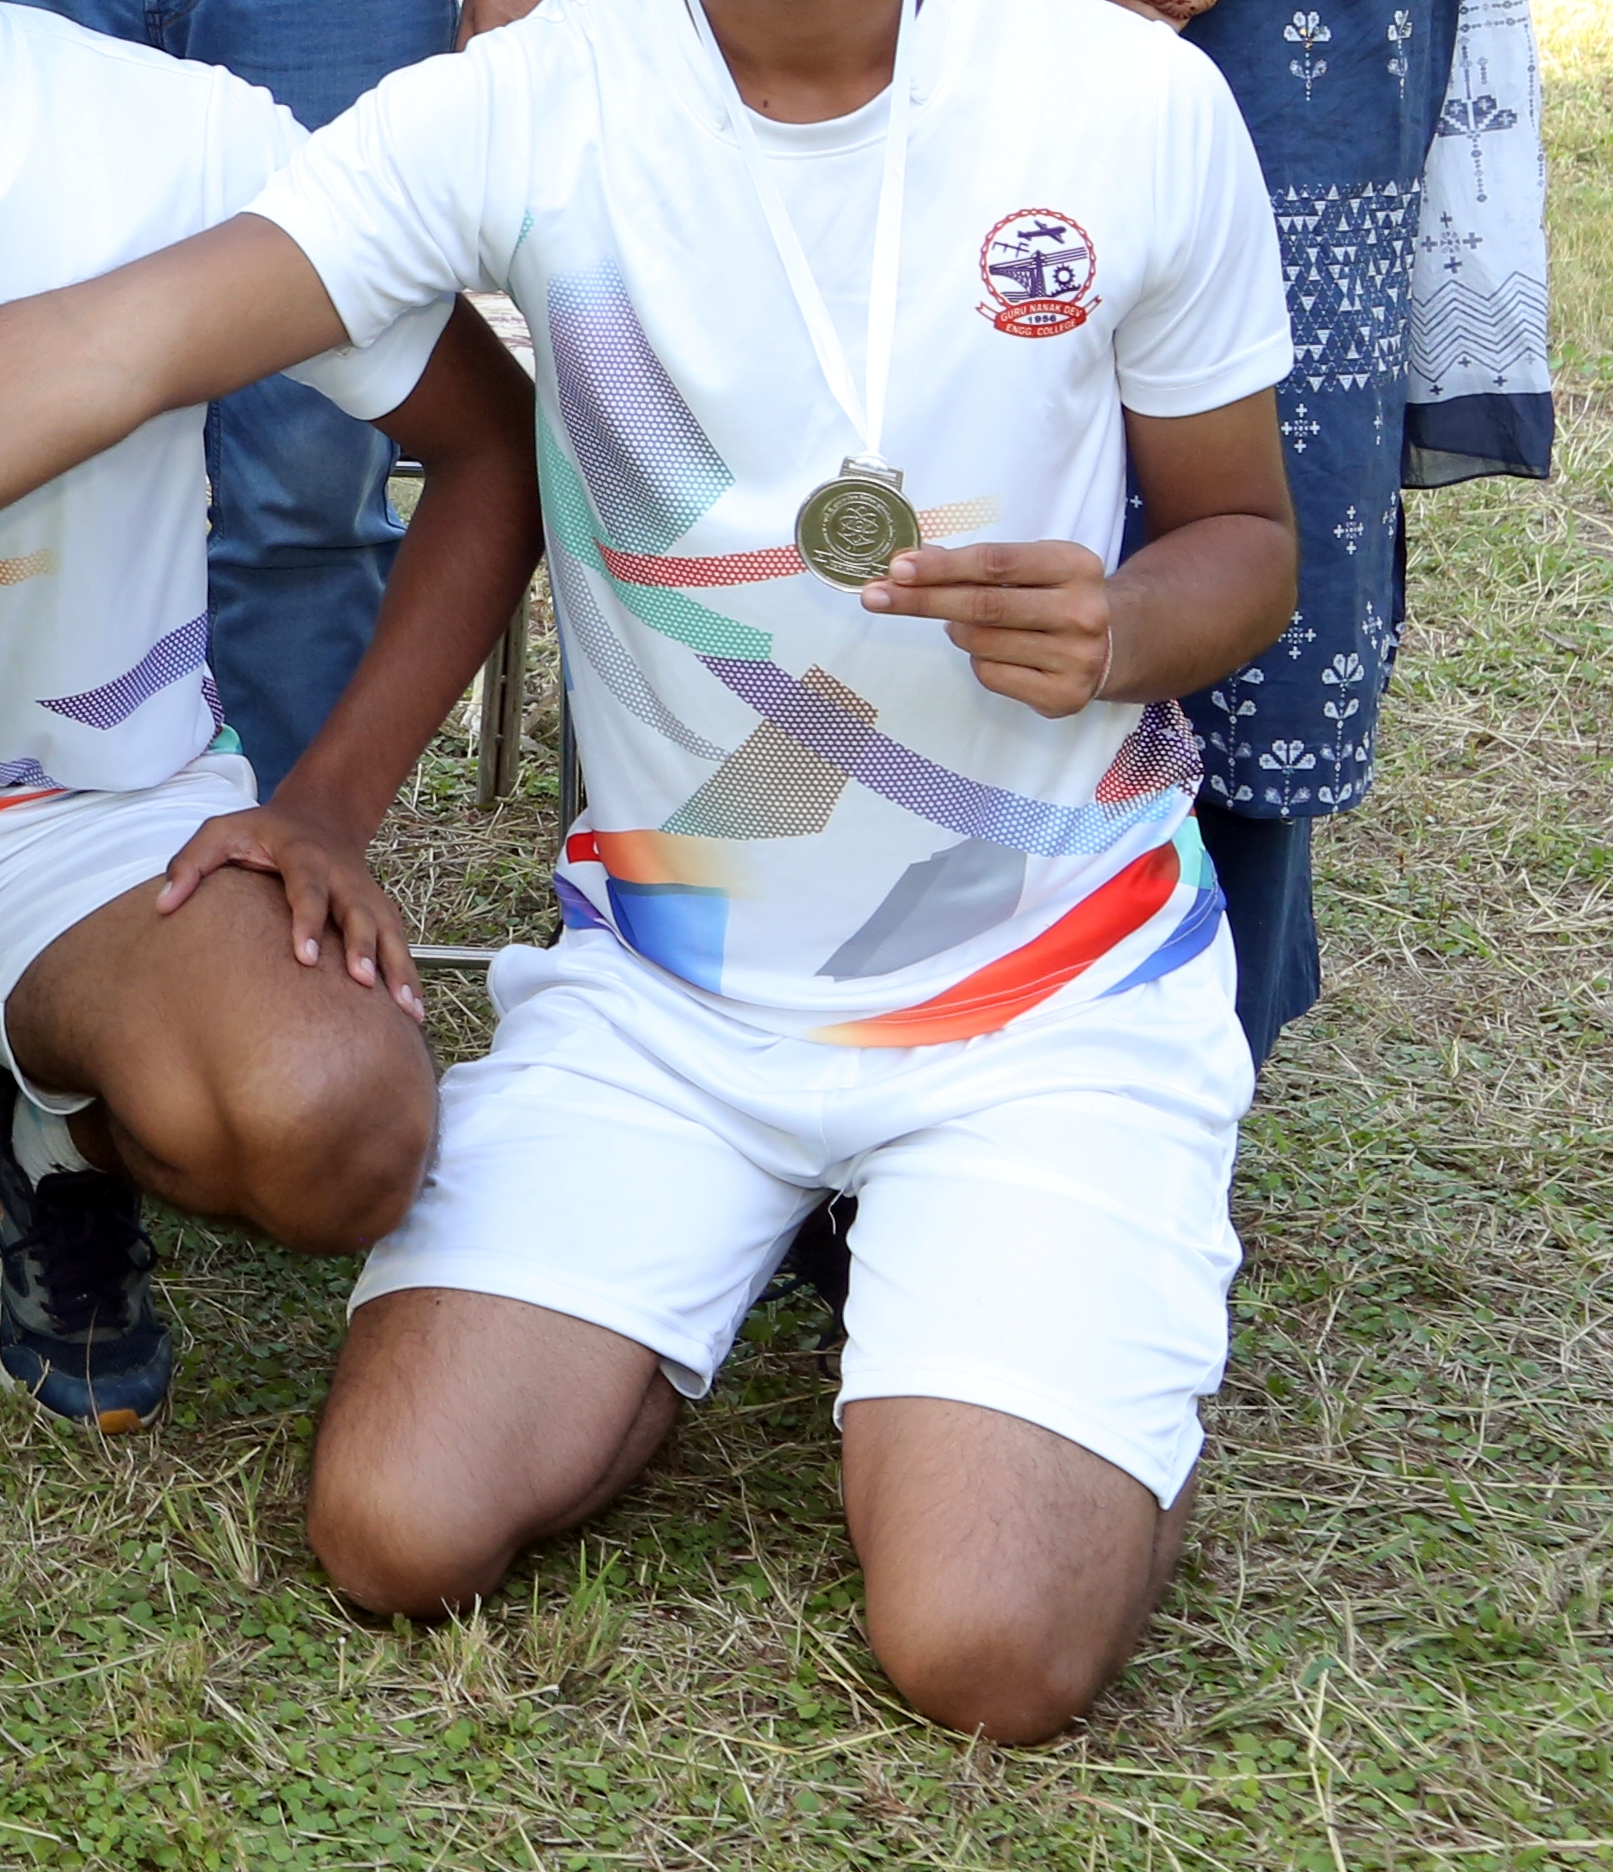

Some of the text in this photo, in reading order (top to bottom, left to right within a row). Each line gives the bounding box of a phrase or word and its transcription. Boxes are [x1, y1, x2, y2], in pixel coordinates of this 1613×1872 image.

[1000, 304, 1083, 321] GURU NANAK DEV
[1028, 314, 1056, 324] 1956
[1037, 319, 1076, 335] COLLEGE
